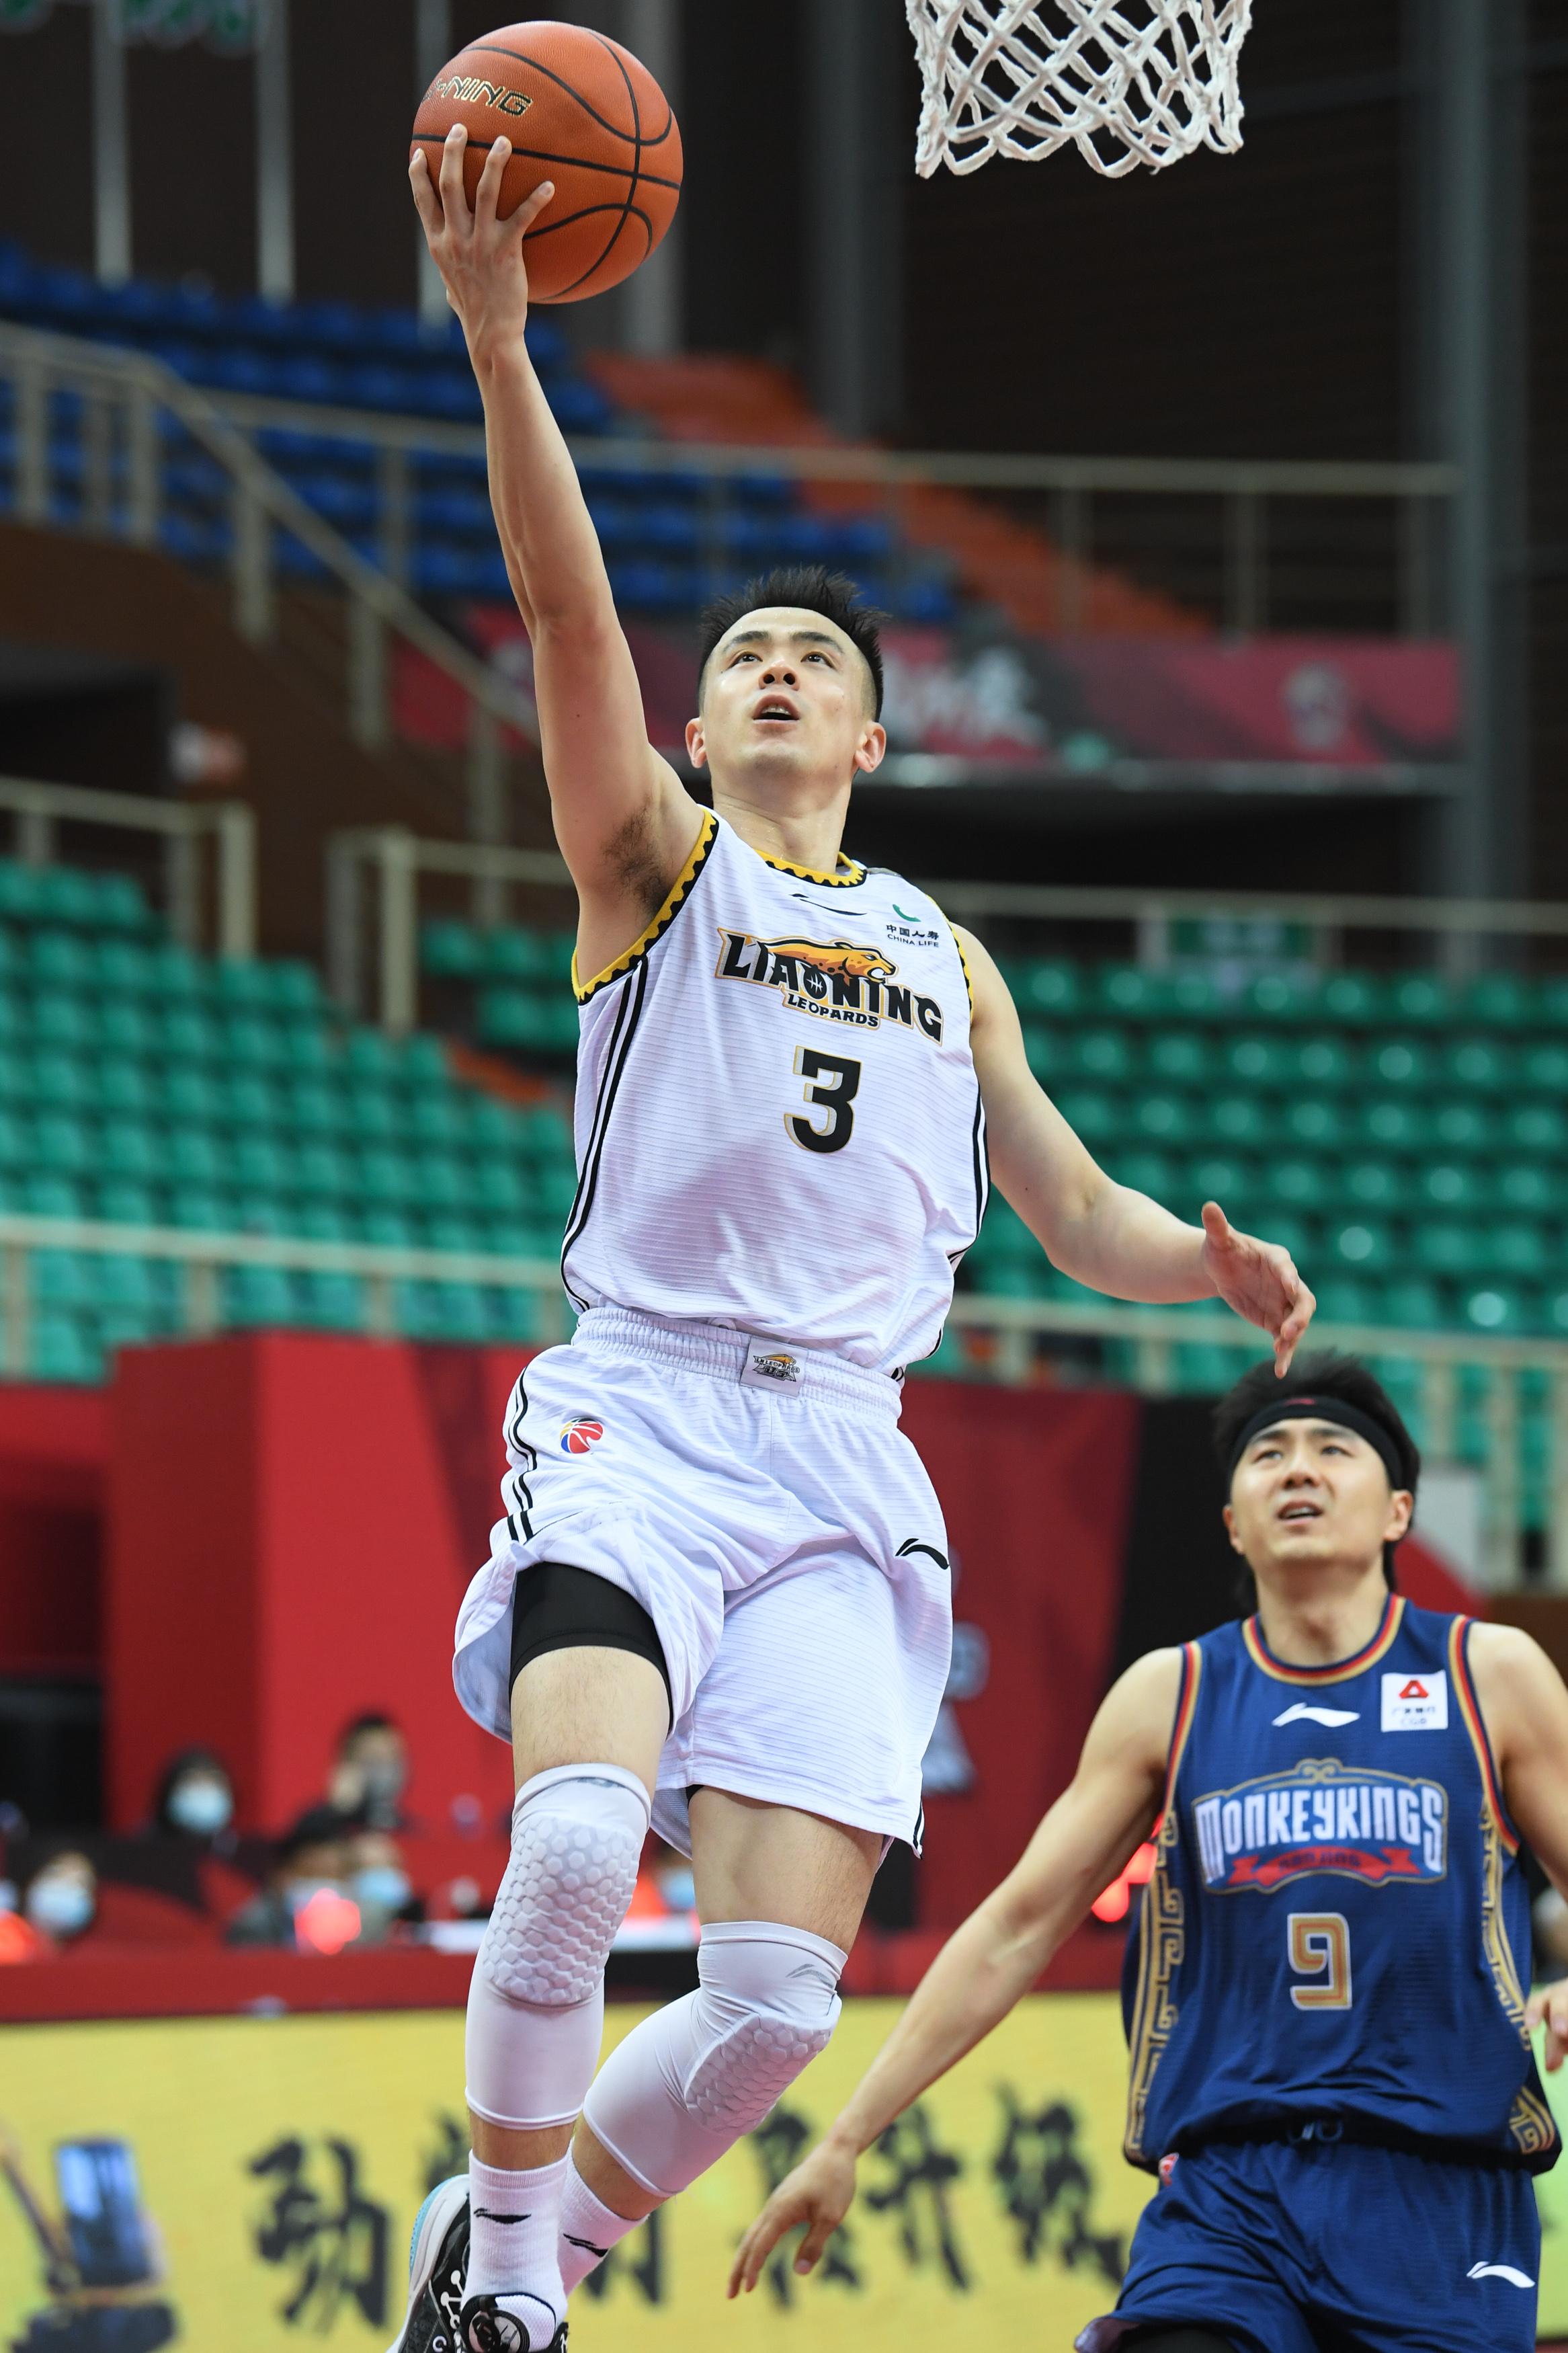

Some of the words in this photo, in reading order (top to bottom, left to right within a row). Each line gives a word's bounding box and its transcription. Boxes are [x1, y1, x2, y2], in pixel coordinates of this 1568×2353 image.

[886, 924, 939, 940] 中国人寿
[887, 934, 915, 945] CHINA
[714, 928, 944, 1046] LIAONING
[787, 994, 879, 1028] LEOPARDS
[784, 1045, 862, 1154] 3
[1288, 1913, 1352, 2010] 9
